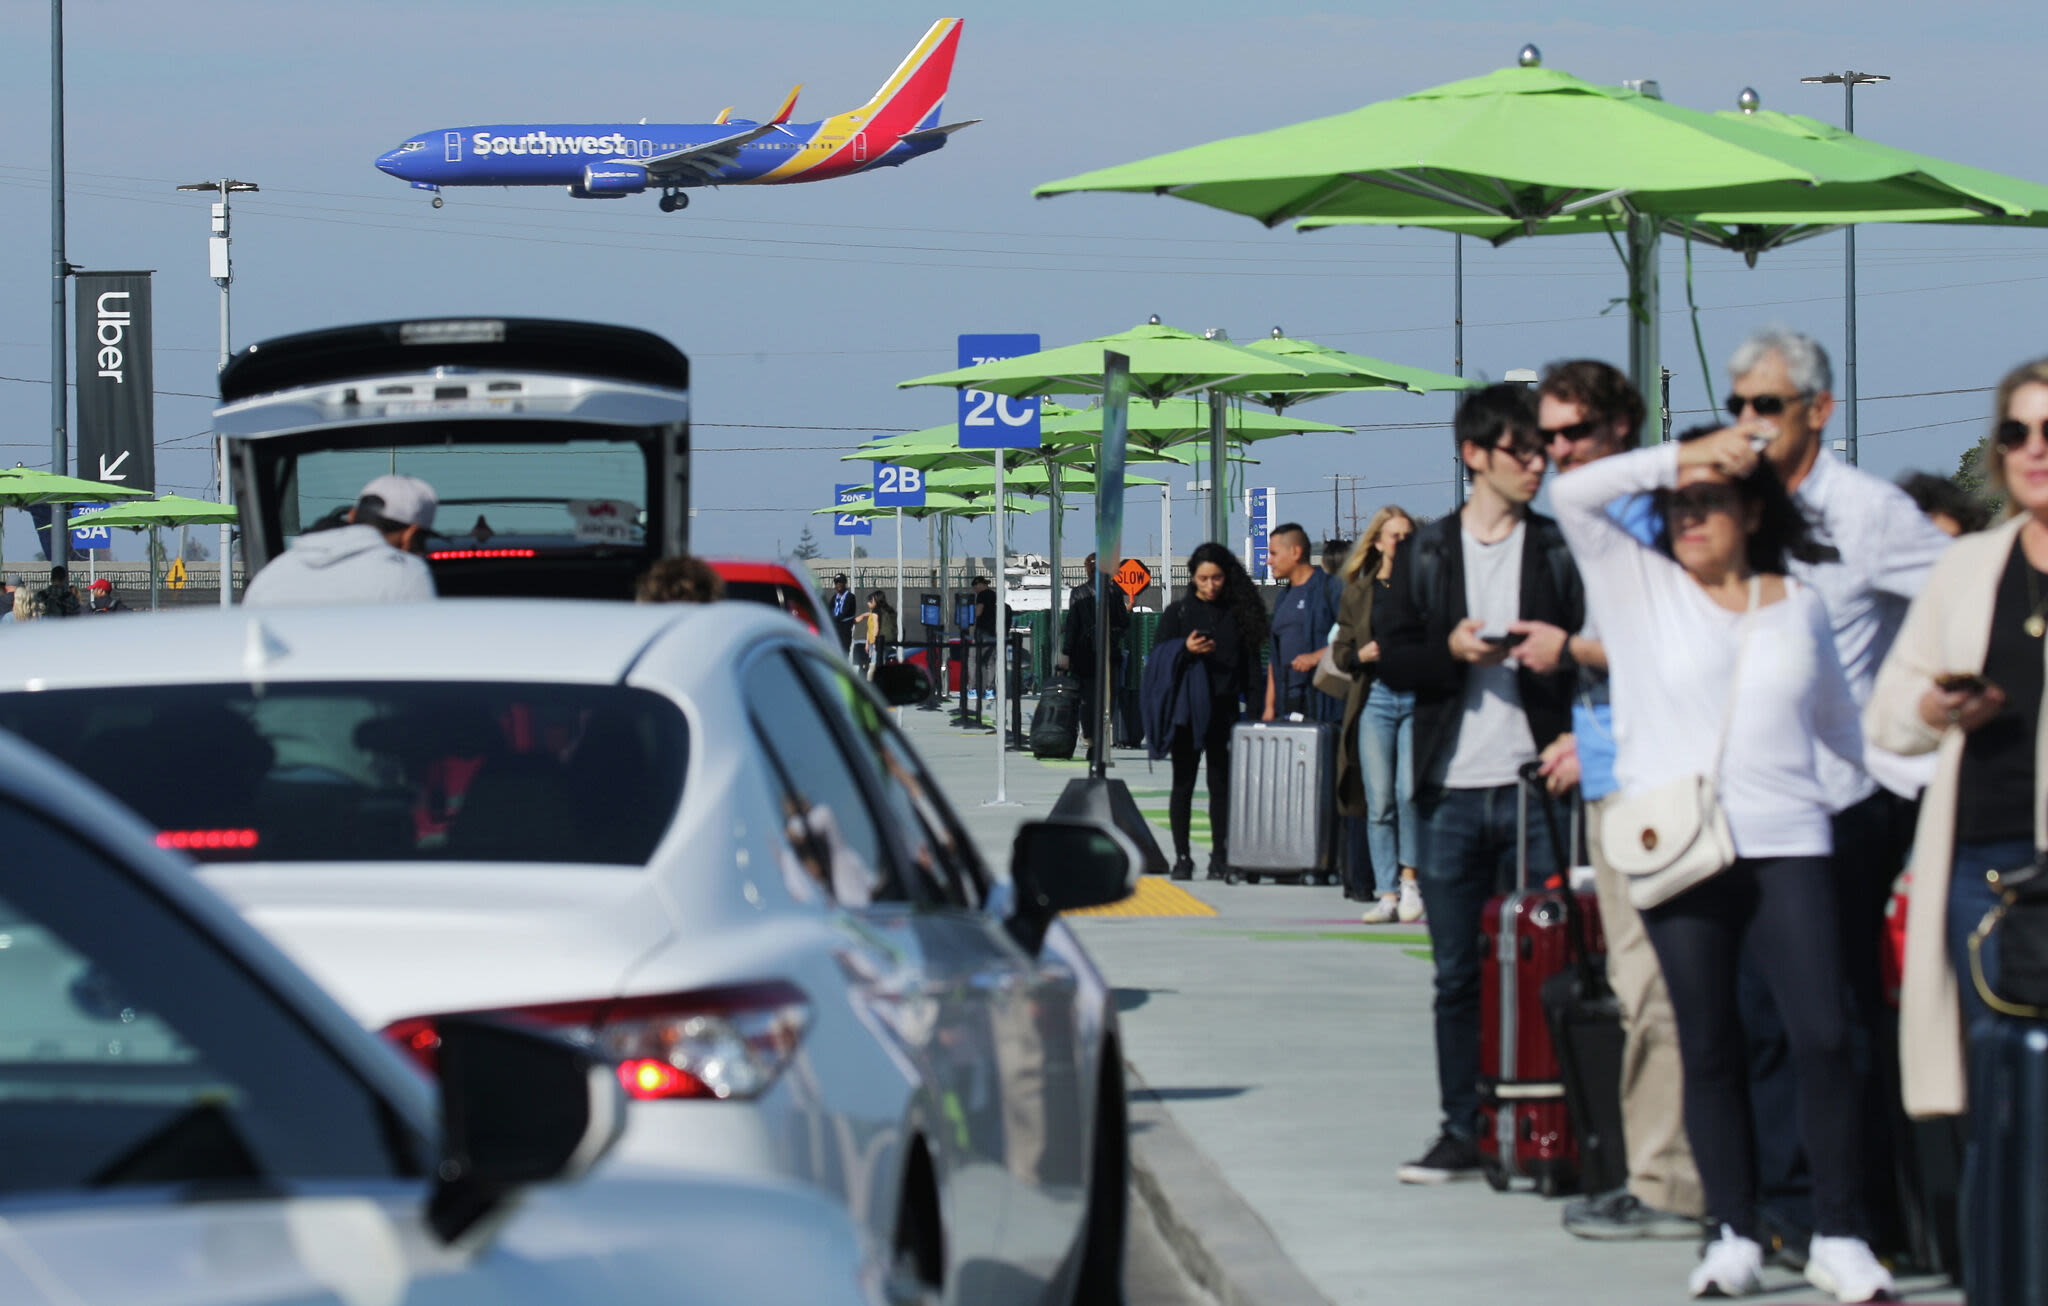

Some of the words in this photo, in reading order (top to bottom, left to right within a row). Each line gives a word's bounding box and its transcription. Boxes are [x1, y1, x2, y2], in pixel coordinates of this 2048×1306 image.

[472, 131, 626, 155] Southwest
[97, 291, 130, 384] Uber
[964, 389, 1034, 427] 2C
[878, 466, 921, 493] 2B
[76, 526, 108, 539] 3A
[1117, 571, 1145, 585] SLOW
